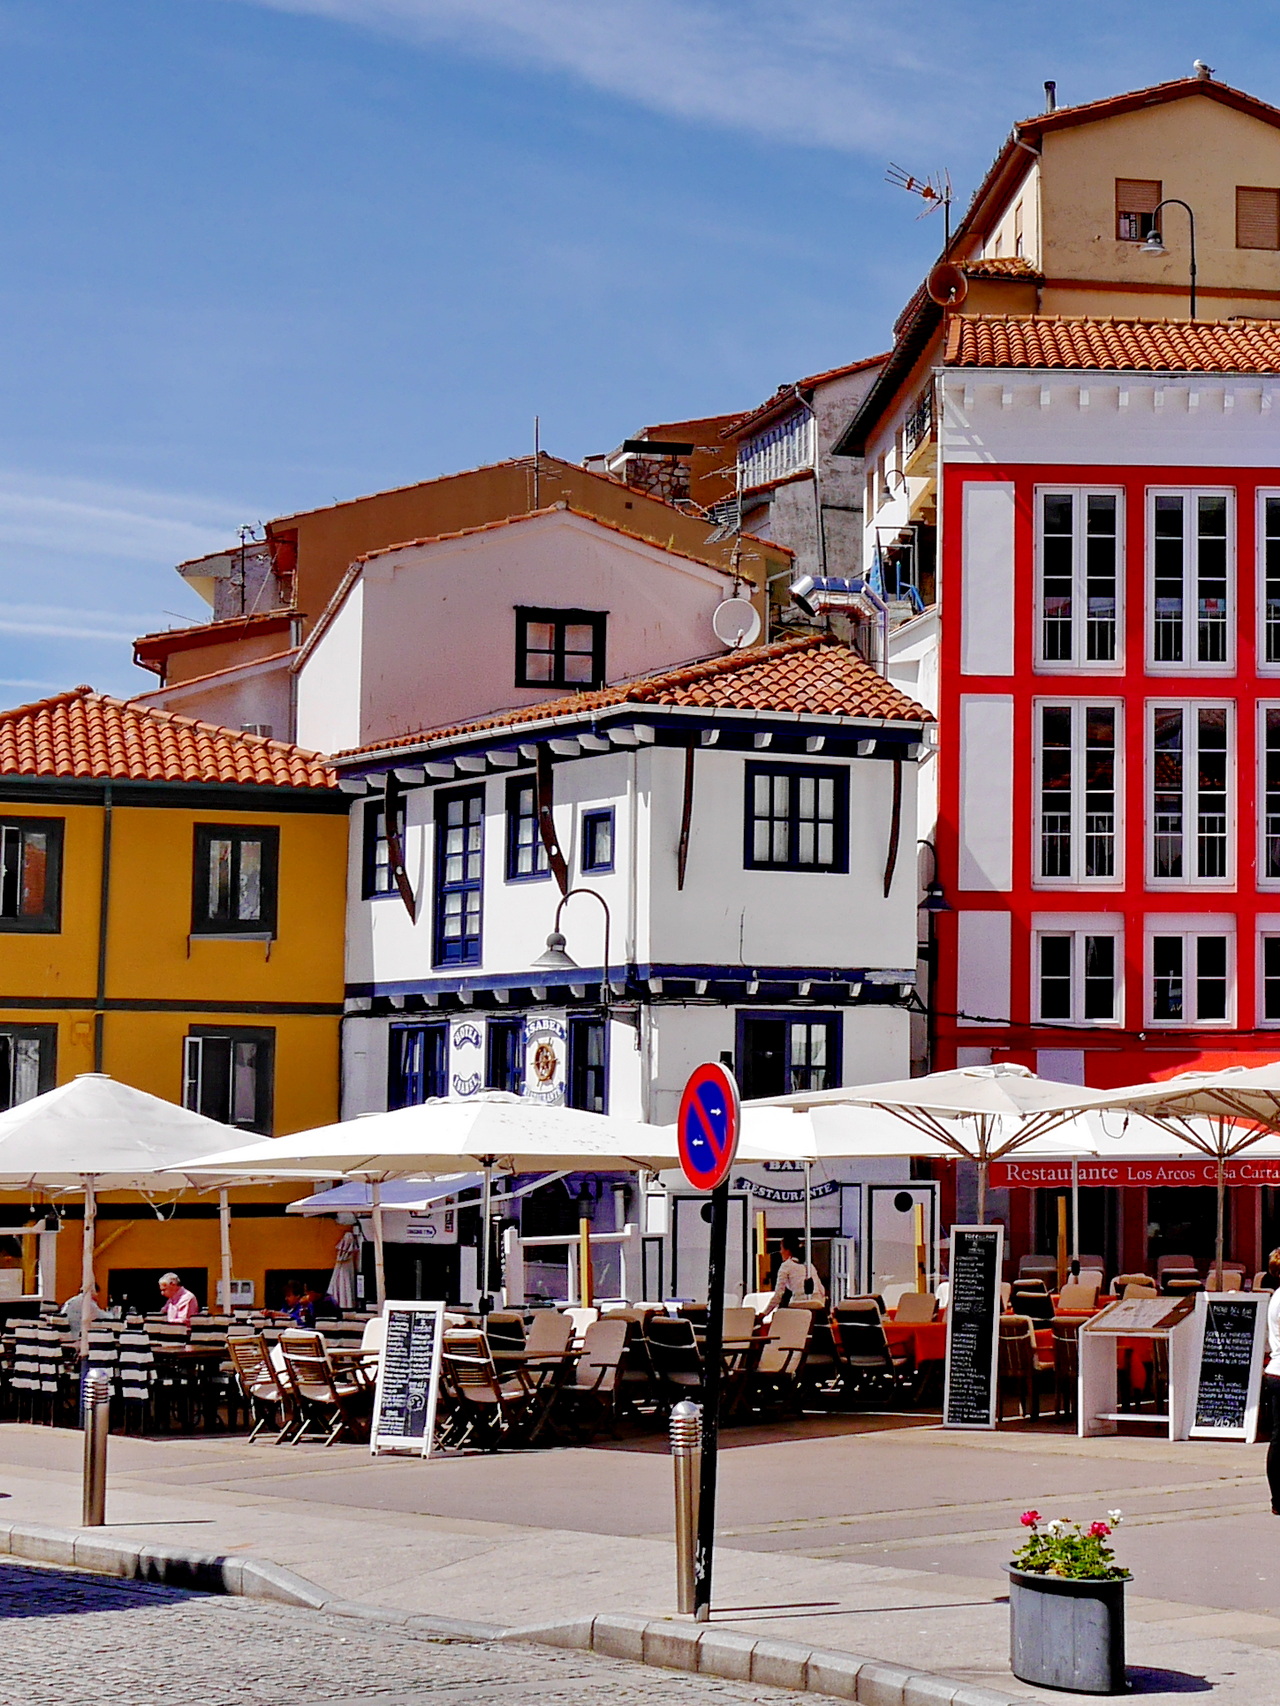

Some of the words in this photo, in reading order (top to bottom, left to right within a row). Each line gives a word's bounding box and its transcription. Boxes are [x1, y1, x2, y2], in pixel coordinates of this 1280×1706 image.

[453, 1024, 481, 1048] HOTEL
[524, 1019, 567, 1039] ISABEL
[1006, 1163, 1119, 1181] Restaurante
[1127, 1166, 1153, 1181] Los
[1156, 1166, 1196, 1180] Arcos
[741, 1180, 834, 1201] RESTAURANTE
